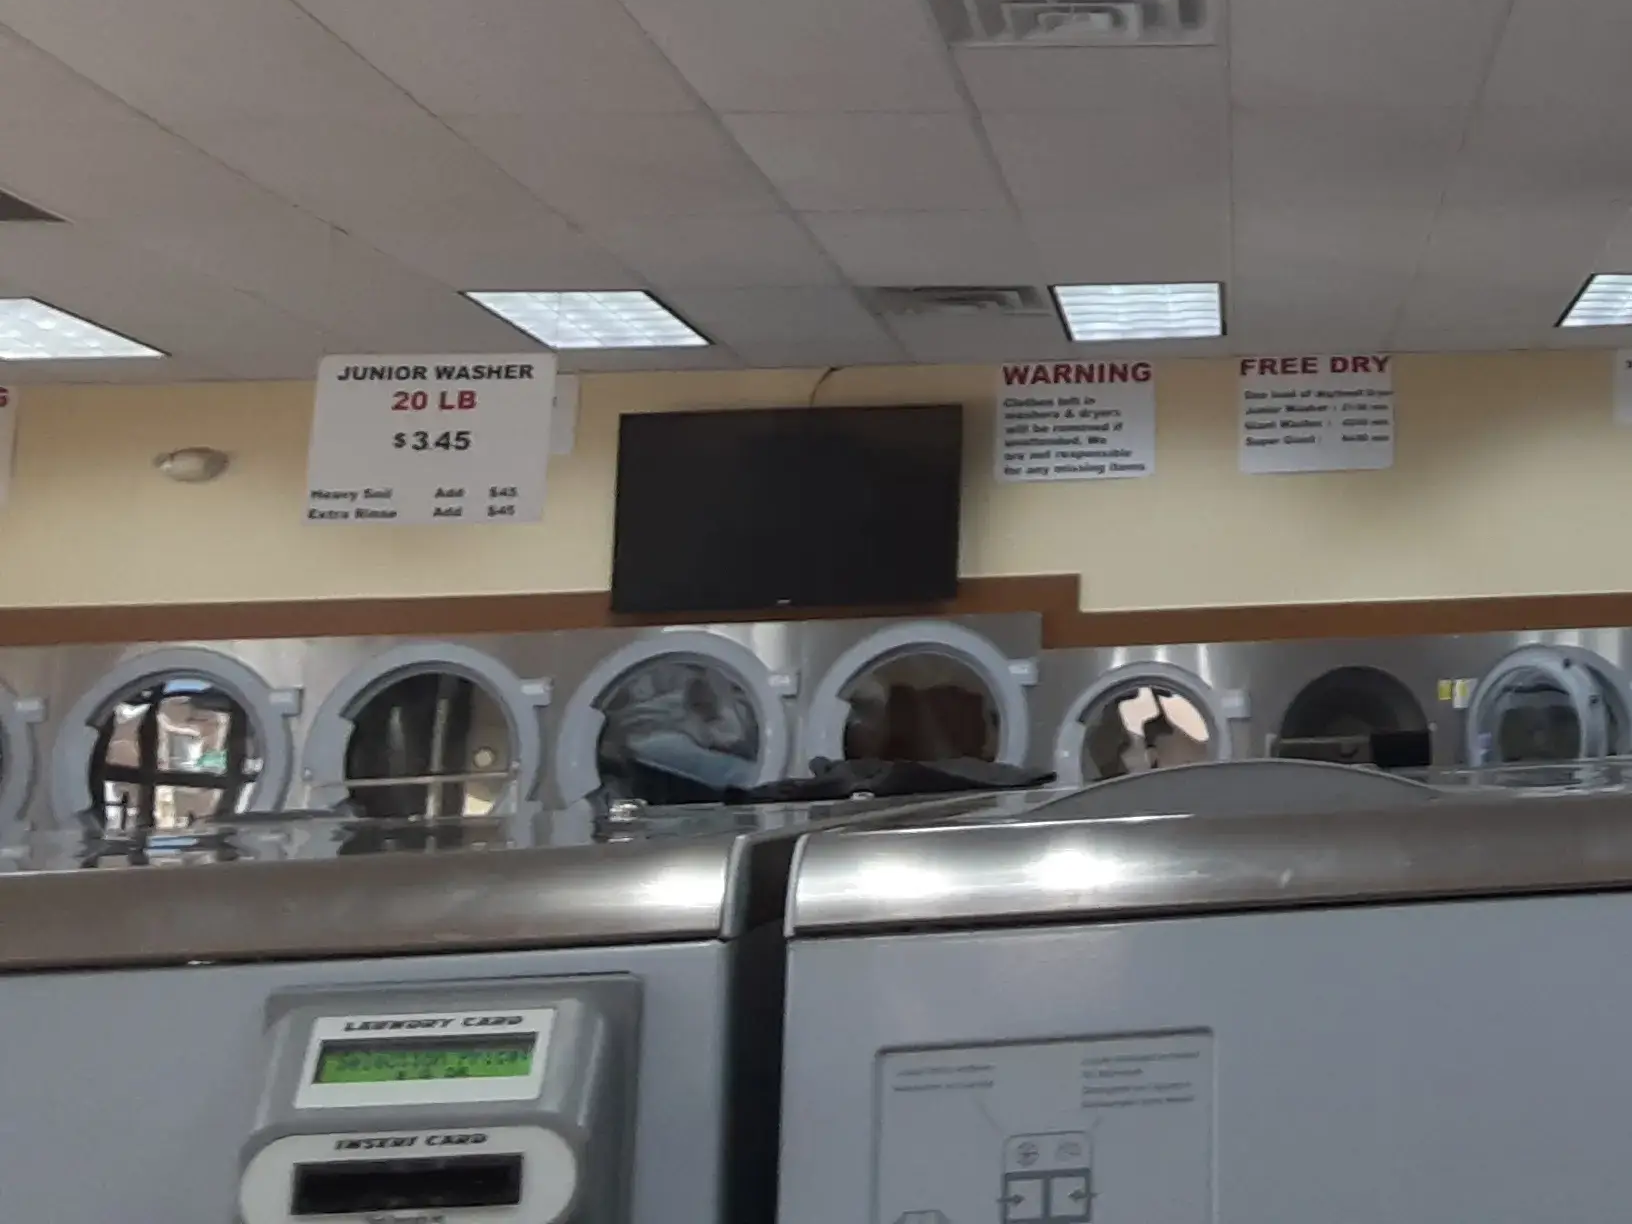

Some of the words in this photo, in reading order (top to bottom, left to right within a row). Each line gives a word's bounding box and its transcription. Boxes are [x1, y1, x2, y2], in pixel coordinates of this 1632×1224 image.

[337, 365, 427, 381] JUNIOR
[434, 364, 535, 380] WASHER
[1003, 362, 1152, 385] WARNING
[1240, 356, 1319, 375] FREE
[1330, 355, 1390, 373] DRY
[391, 390, 428, 411] 20
[439, 390, 477, 410] LB
[461, 1015, 523, 1027] CARD
[334, 1135, 419, 1151] INSERT
[424, 1133, 488, 1147] CARD
